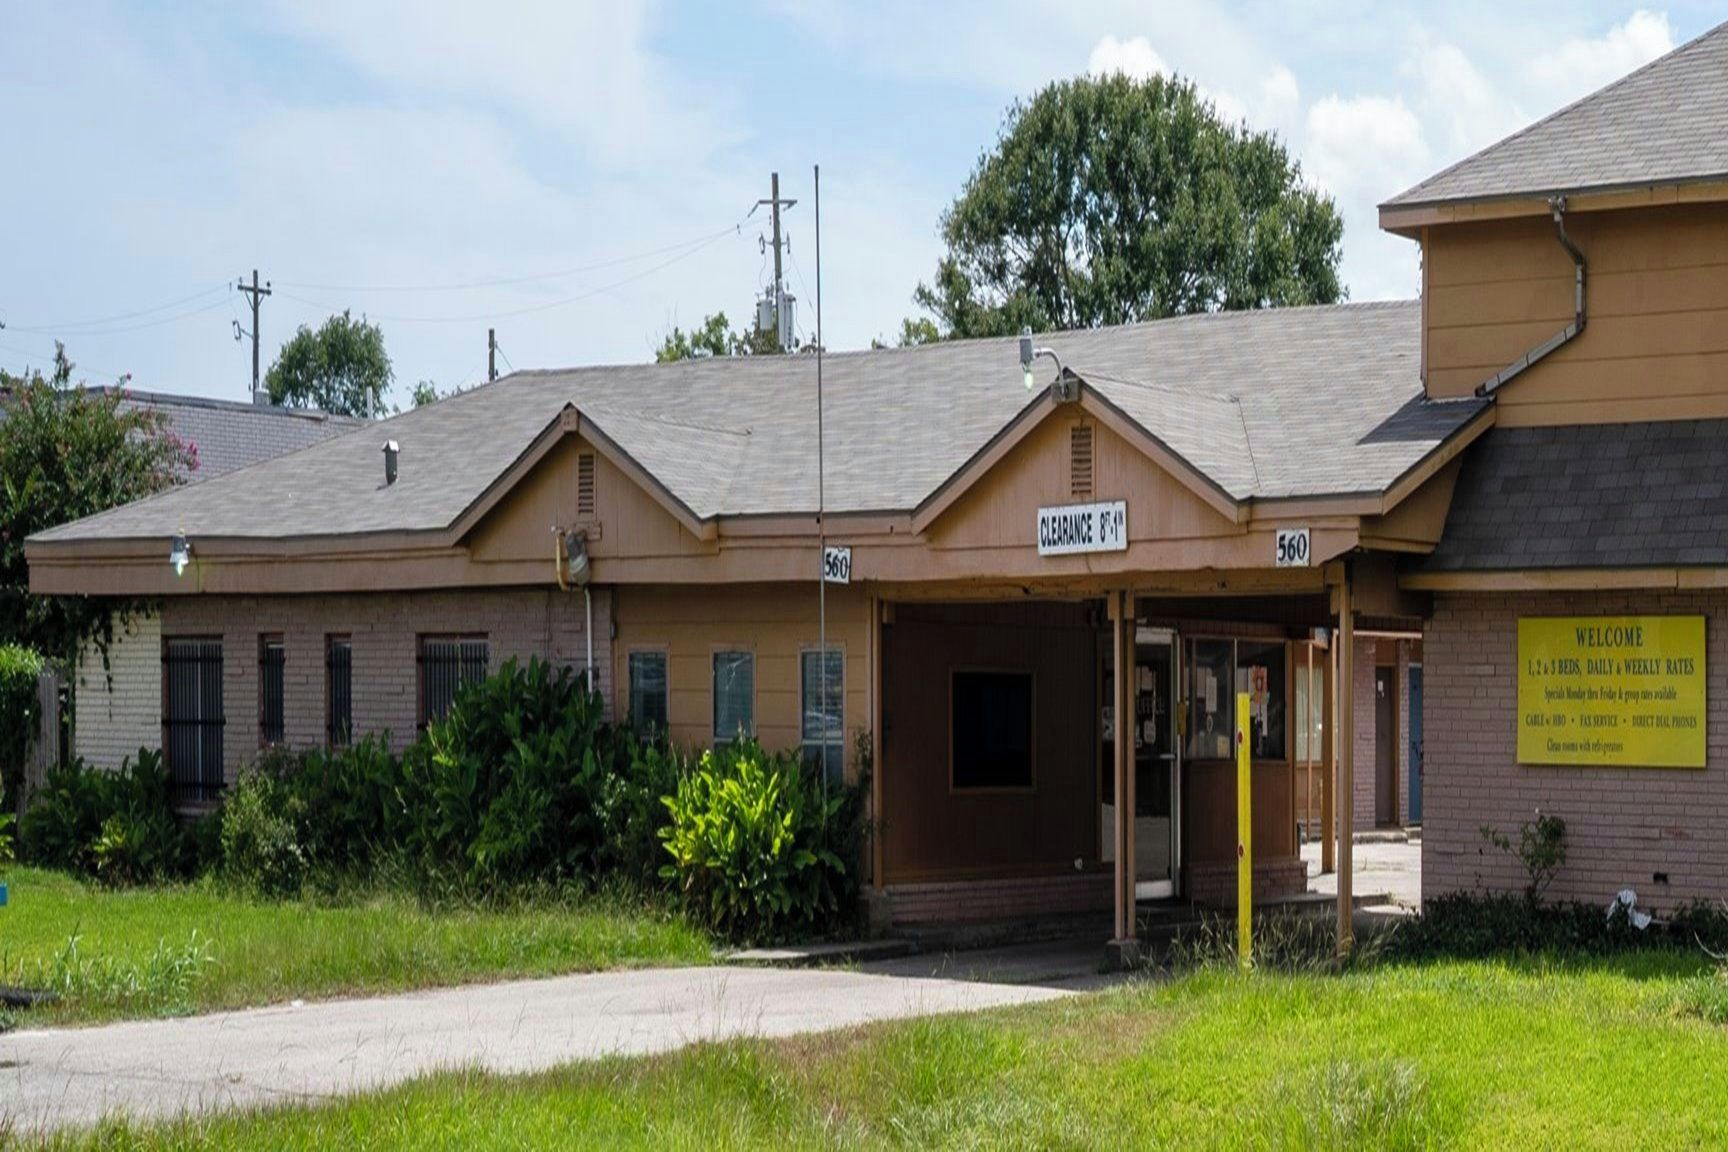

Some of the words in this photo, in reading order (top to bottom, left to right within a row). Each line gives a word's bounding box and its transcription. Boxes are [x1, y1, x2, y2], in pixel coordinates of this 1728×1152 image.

[1041, 513, 1093, 548] CLEARANCE
[1278, 533, 1307, 562] 560
[823, 551, 849, 579] 560
[1575, 626, 1644, 648] WELCOME
[1551, 659, 1556, 675] 3
[1558, 659, 1582, 677] BEDS,
[1587, 659, 1614, 675] DAILY
[1624, 659, 1661, 675] WEEKLY
[1666, 659, 1694, 675] RATES
[1566, 686, 1585, 704] Monday
[1600, 686, 1617, 704] Friday
[1526, 714, 1544, 727] CABLE
[1553, 715, 1566, 727] HBO
[1580, 715, 1592, 727] FAX
[1593, 715, 1618, 728] SERVICE
[1632, 715, 1654, 727] DIRECT
[1656, 715, 1670, 728] DIAL
[1671, 715, 1697, 728] PHONES
